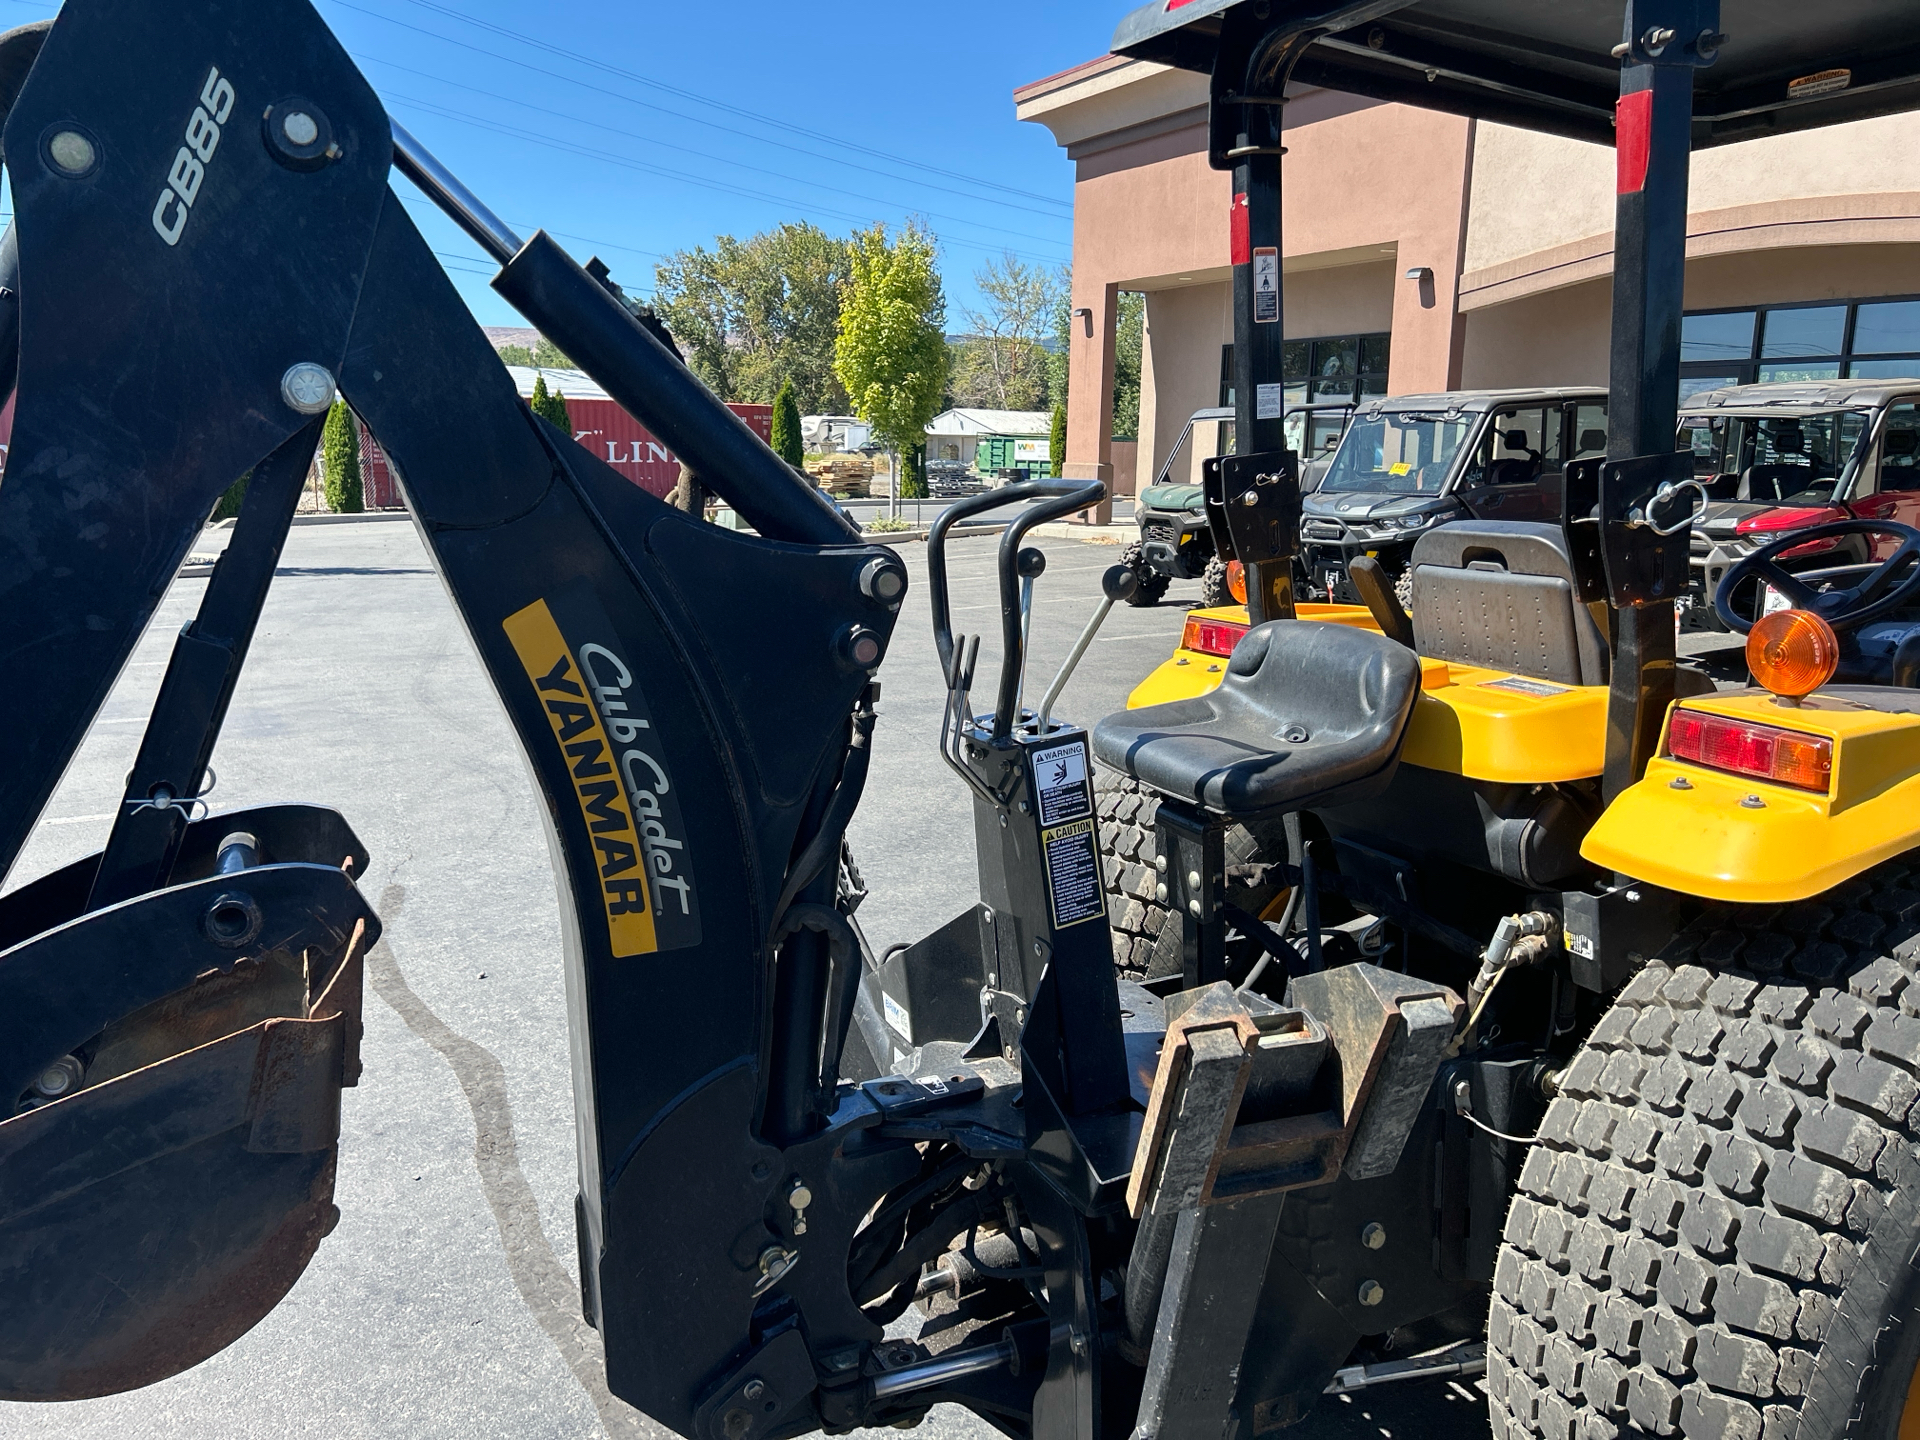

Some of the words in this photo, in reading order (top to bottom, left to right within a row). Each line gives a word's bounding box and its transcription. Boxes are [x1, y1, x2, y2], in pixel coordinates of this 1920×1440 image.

[152, 66, 235, 246] CB85
[606, 441, 681, 463] LIN
[536, 654, 645, 916] YANMAR
[579, 642, 650, 744] Cub
[622, 749, 690, 915] Cadet
[1044, 745, 1082, 759] WARNING
[1056, 820, 1091, 838] CAUTION
